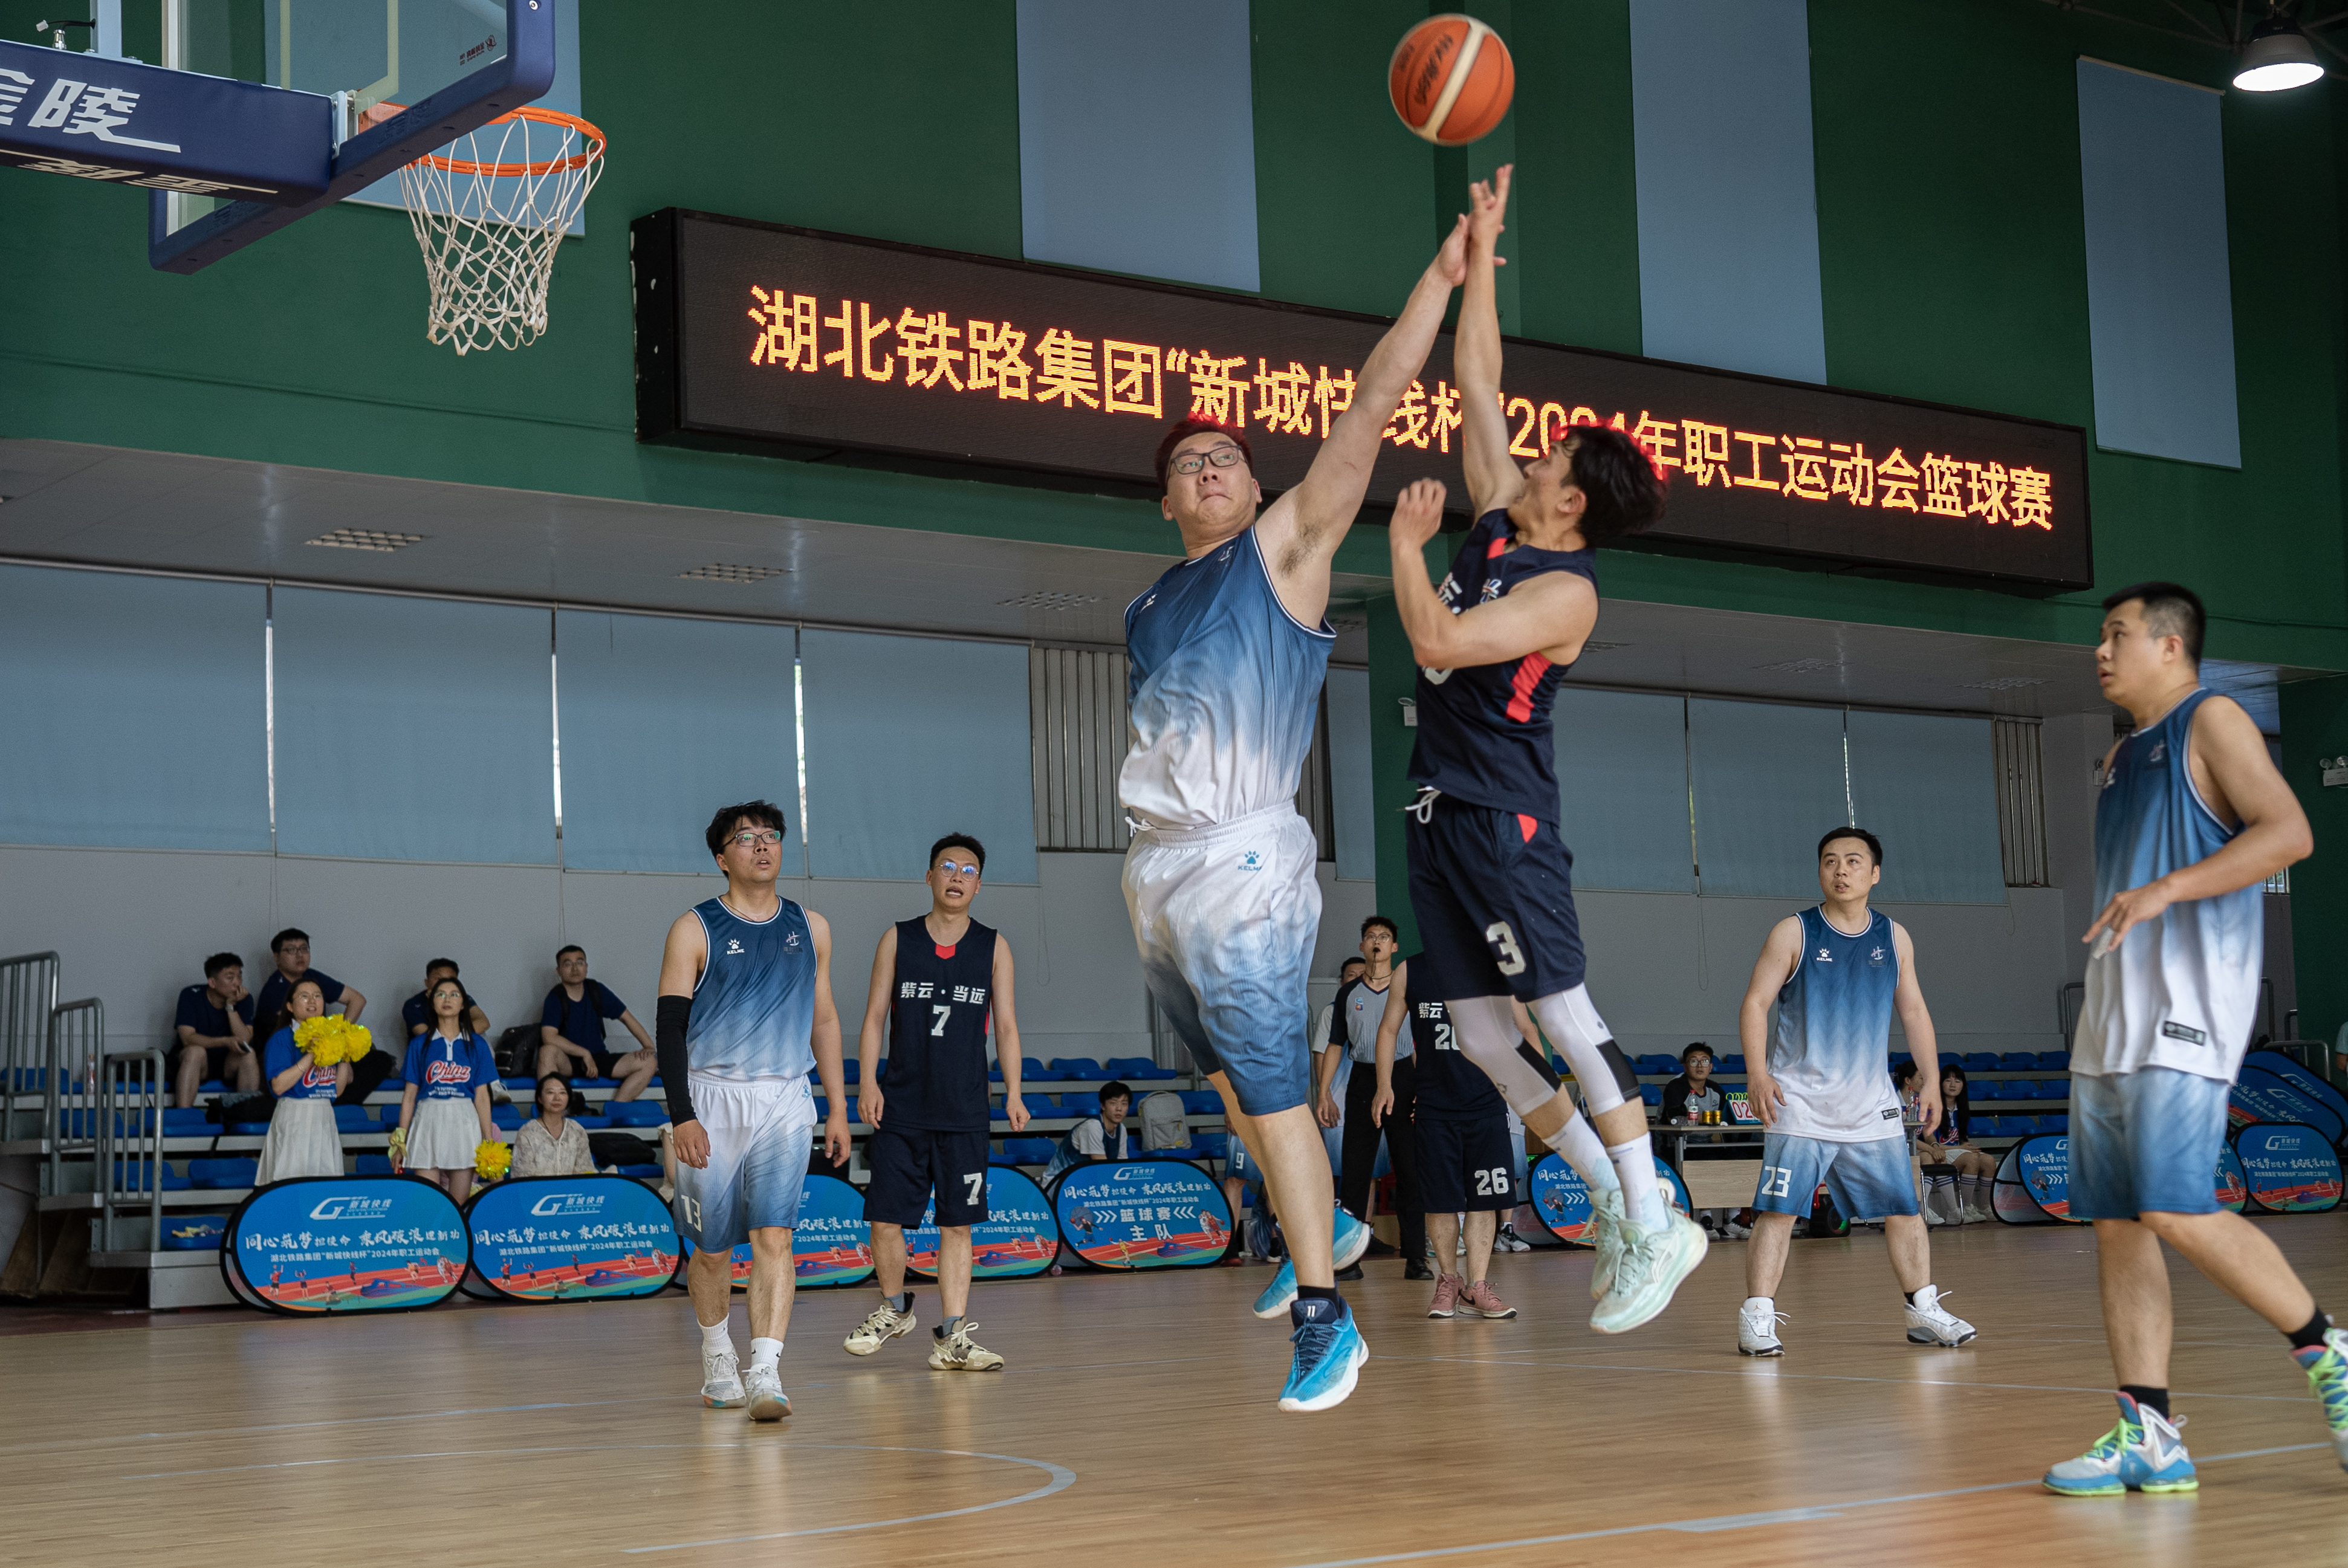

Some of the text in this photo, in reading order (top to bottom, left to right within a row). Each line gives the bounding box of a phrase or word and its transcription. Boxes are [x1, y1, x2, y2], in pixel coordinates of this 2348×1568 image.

[1485, 921, 1526, 976] 3
[930, 1004, 951, 1037] 7
[426, 1060, 472, 1085] China
[1236, 1152, 1250, 1169] 9
[964, 1173, 983, 1205] 7
[1474, 1167, 1509, 1195] 26
[1762, 1165, 1792, 1197] 23
[349, 1199, 392, 1209] 新城快线
[566, 1195, 605, 1205] 新城快线
[681, 1194, 702, 1233] 13
[1120, 1207, 1171, 1222] 篮球赛
[1130, 1224, 1173, 1242] 主队
[1308, 1305, 1316, 1317] 11
